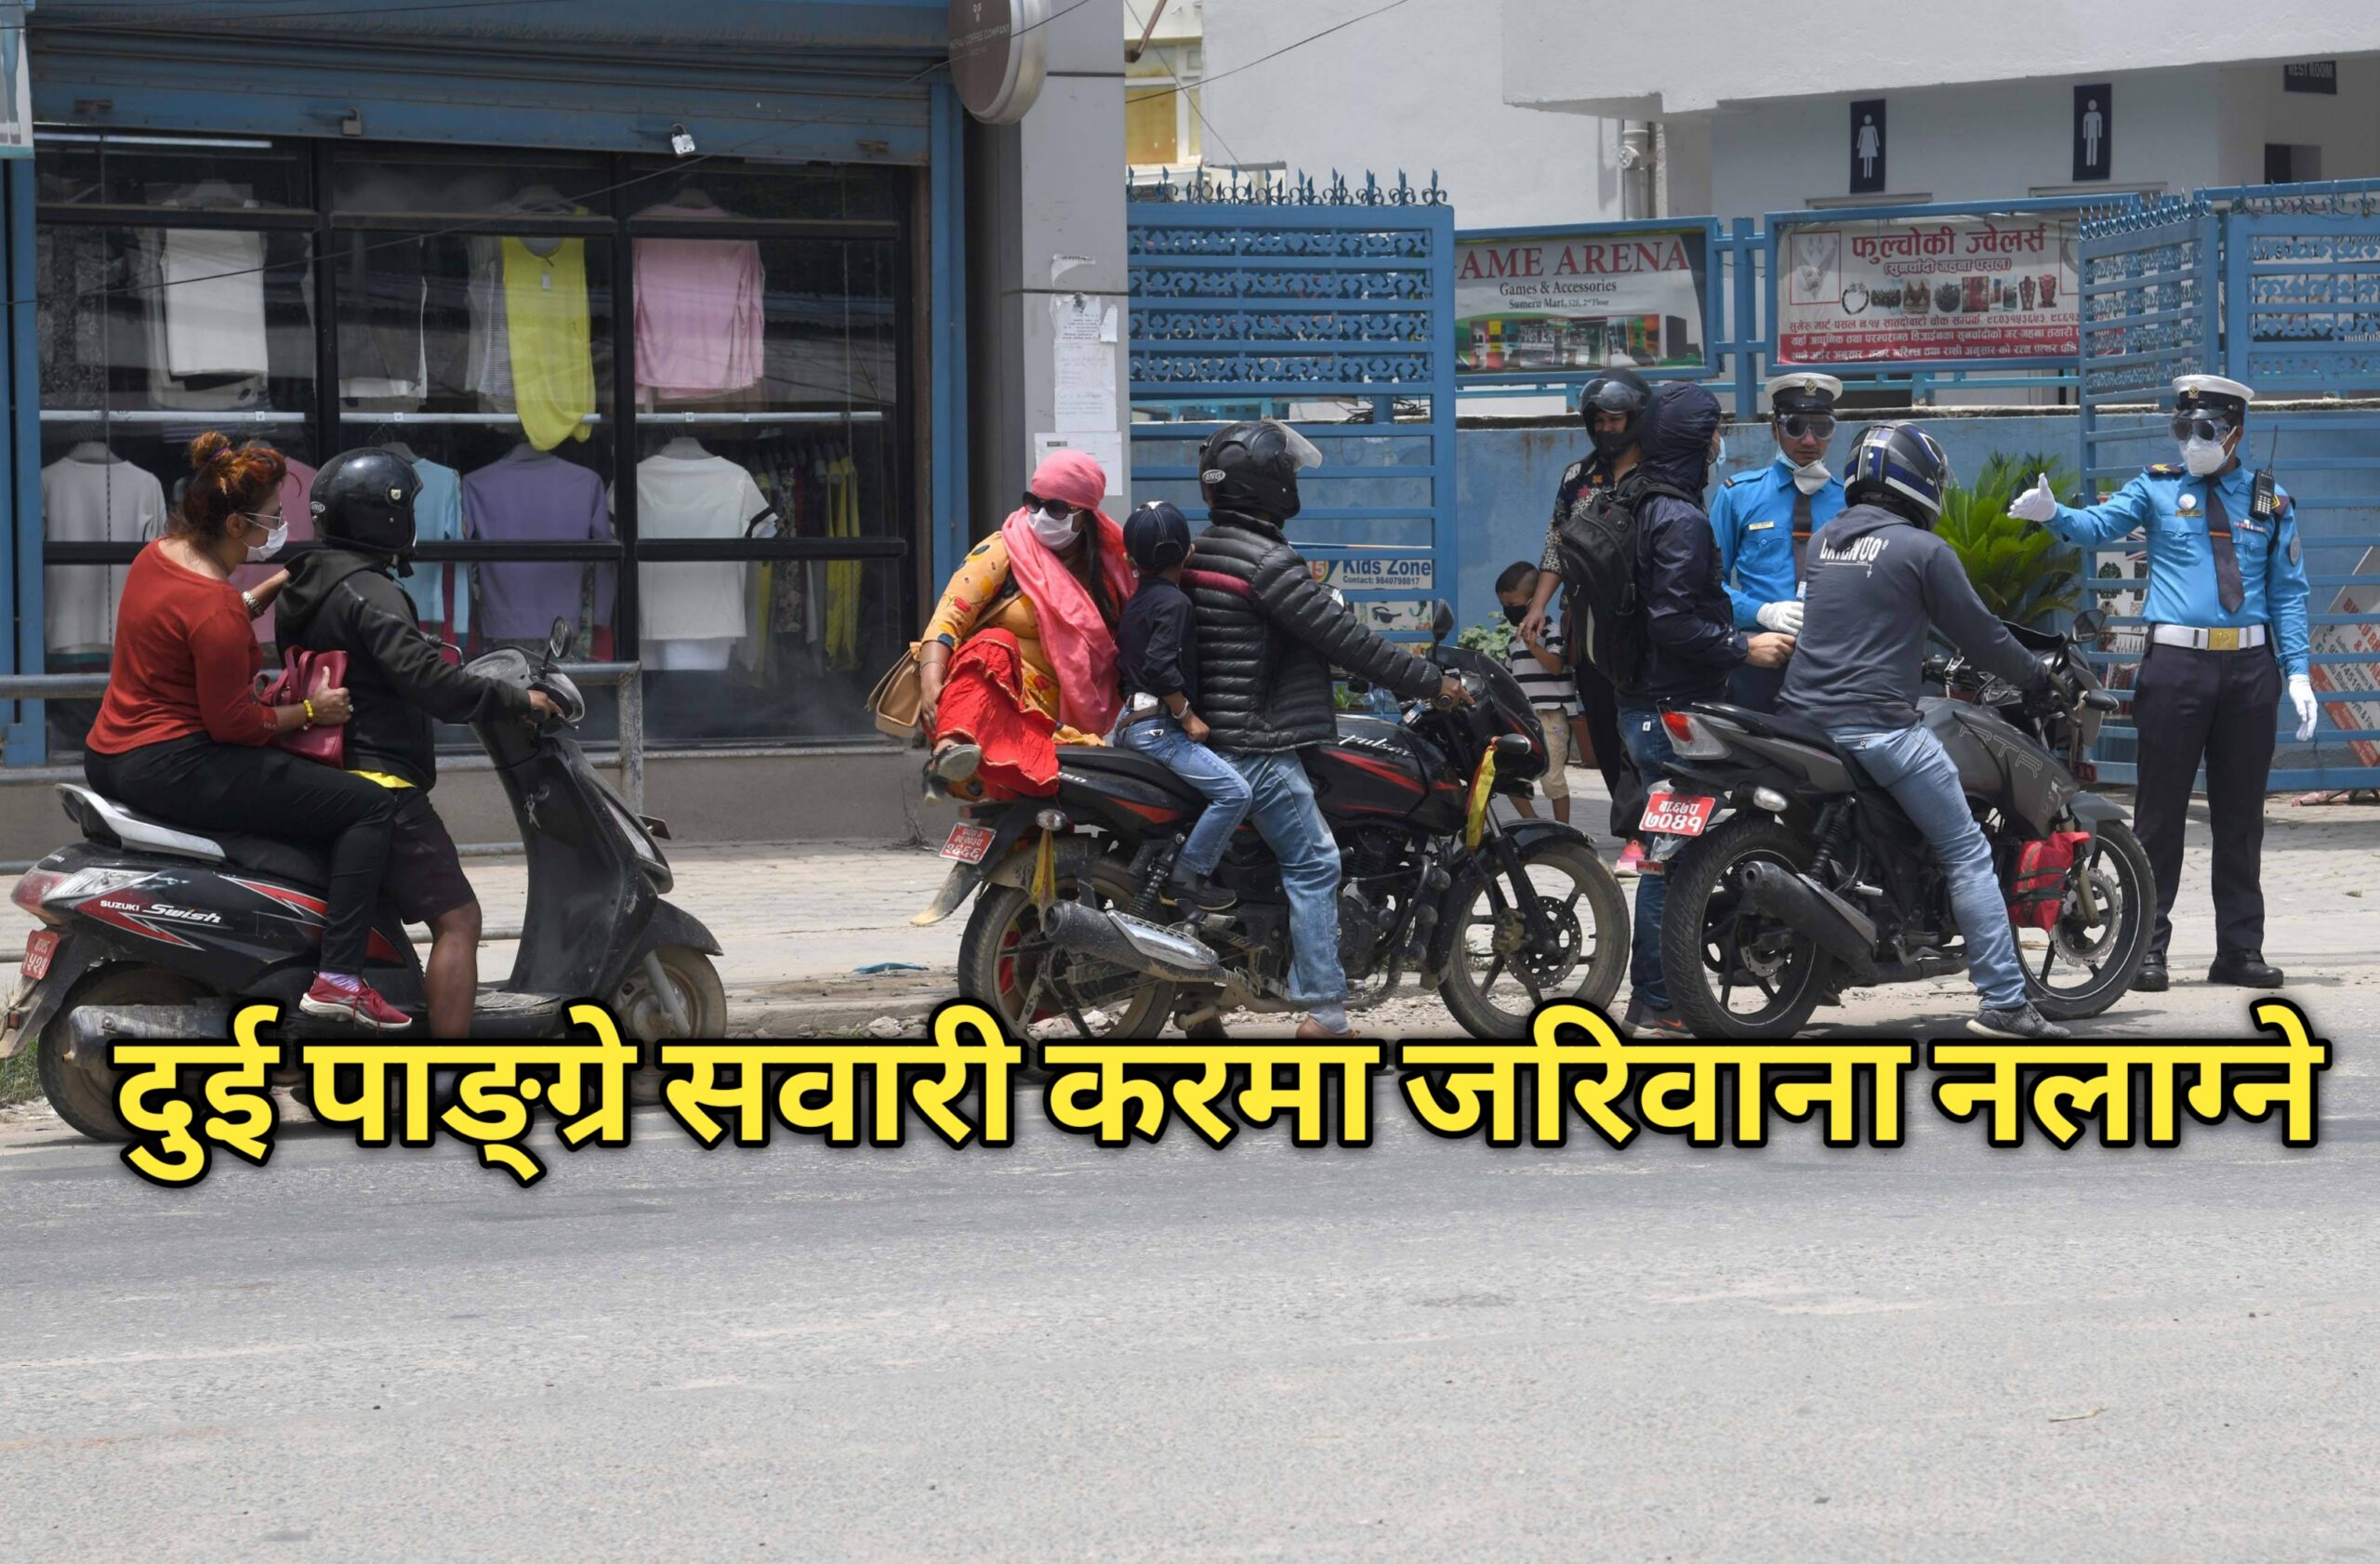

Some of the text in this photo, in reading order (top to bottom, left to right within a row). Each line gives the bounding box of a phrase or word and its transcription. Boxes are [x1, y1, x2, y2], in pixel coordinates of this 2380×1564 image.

[1965, 222, 2047, 254] ज्वेलर्स
[1454, 240, 1691, 279] AME ARENA
[1500, 278, 1617, 298] Games & Accessories
[1509, 298, 1542, 310] Sumeru
[1543, 297, 1567, 309] Mart,
[1593, 298, 1610, 307] Floor
[1342, 560, 1382, 575] Kids
[1387, 560, 1431, 577] Zone
[1342, 576, 1374, 585] Contact:
[1958, 723, 2043, 779] RTR
[99, 899, 221, 924] SUZUKI Swish
